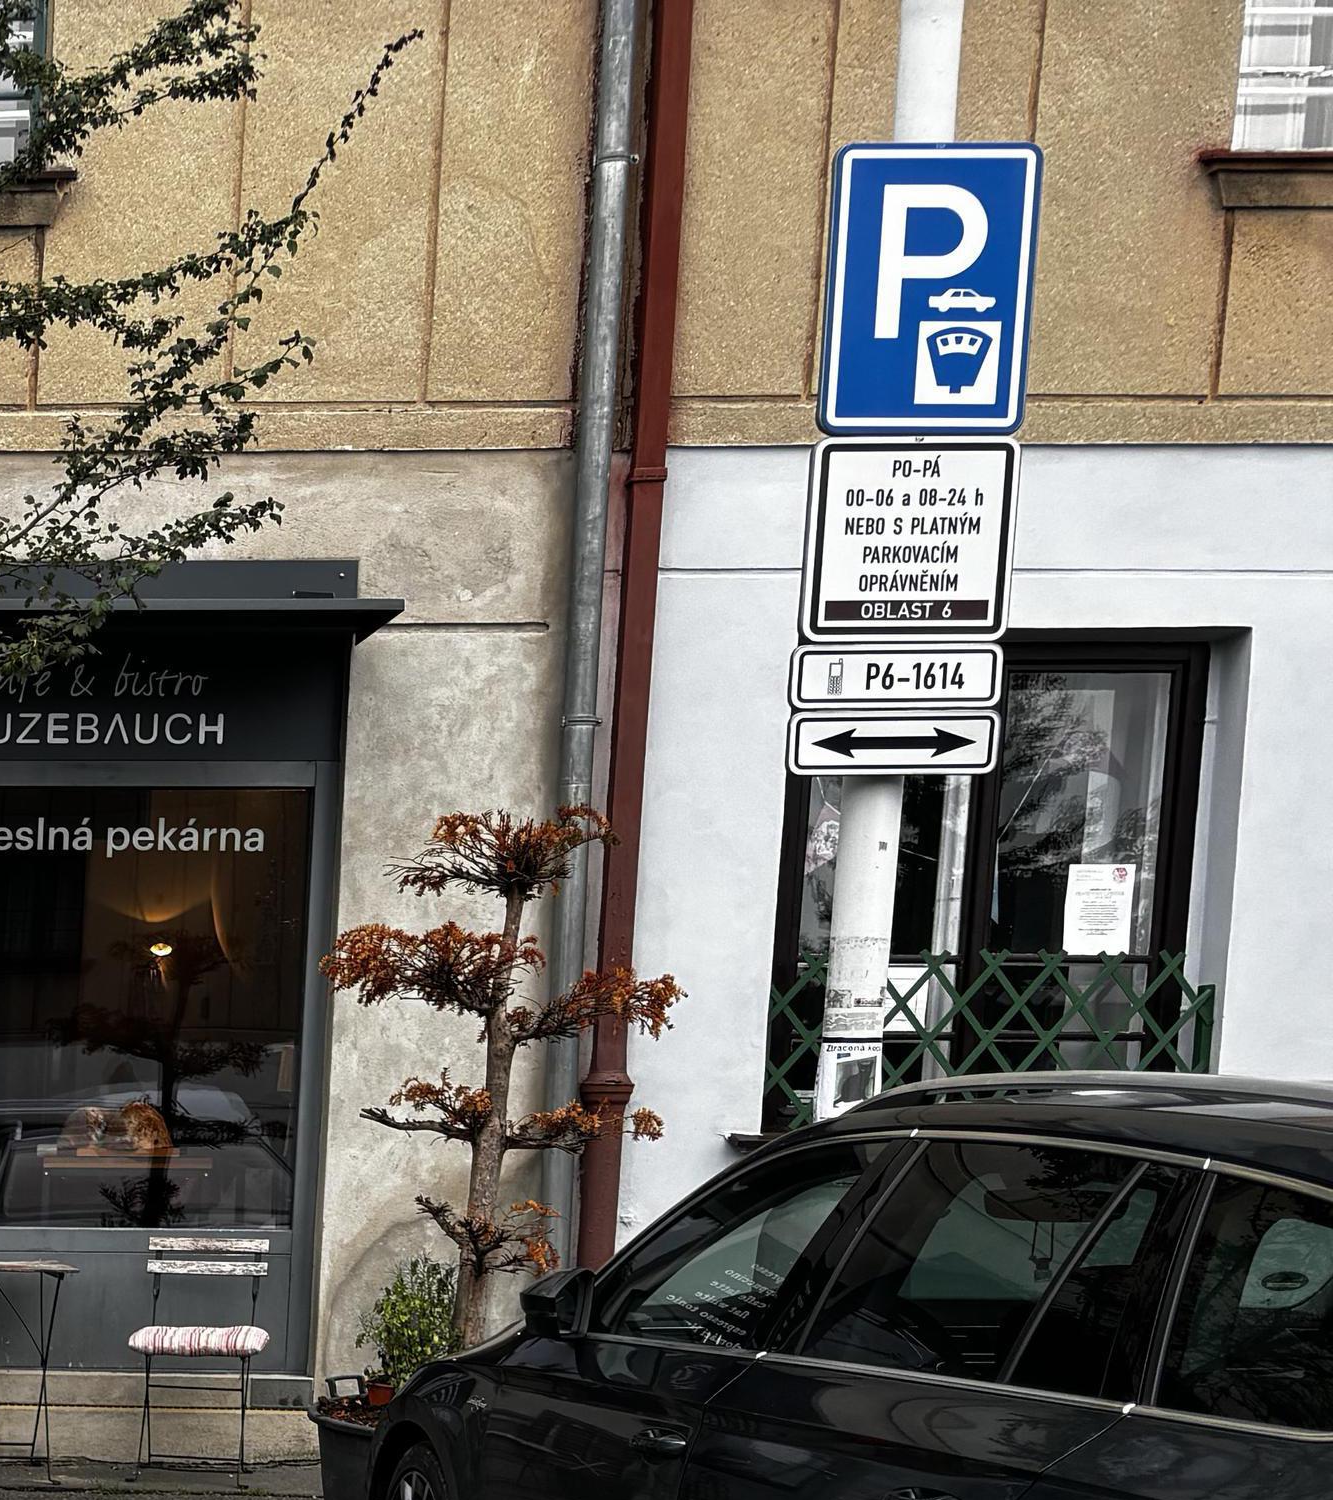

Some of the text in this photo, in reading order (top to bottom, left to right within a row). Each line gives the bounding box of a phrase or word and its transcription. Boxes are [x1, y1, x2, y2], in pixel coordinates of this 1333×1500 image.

[874, 183, 989, 339] P
[893, 455, 940, 477] PO-PÁ
[847, 488, 983, 506] 00-06 a 08-24 h
[845, 512, 980, 535] NEBO S PLATNÝM
[863, 541, 958, 563] PARKOVACÍM
[859, 570, 958, 591] OPRÁVNĚNÍM
[861, 603, 951, 618] OBLAST 6
[70, 663, 95, 697] &
[114, 653, 208, 697] bistro
[866, 663, 964, 690] P6-1614
[106, 818, 266, 858] pekárna
